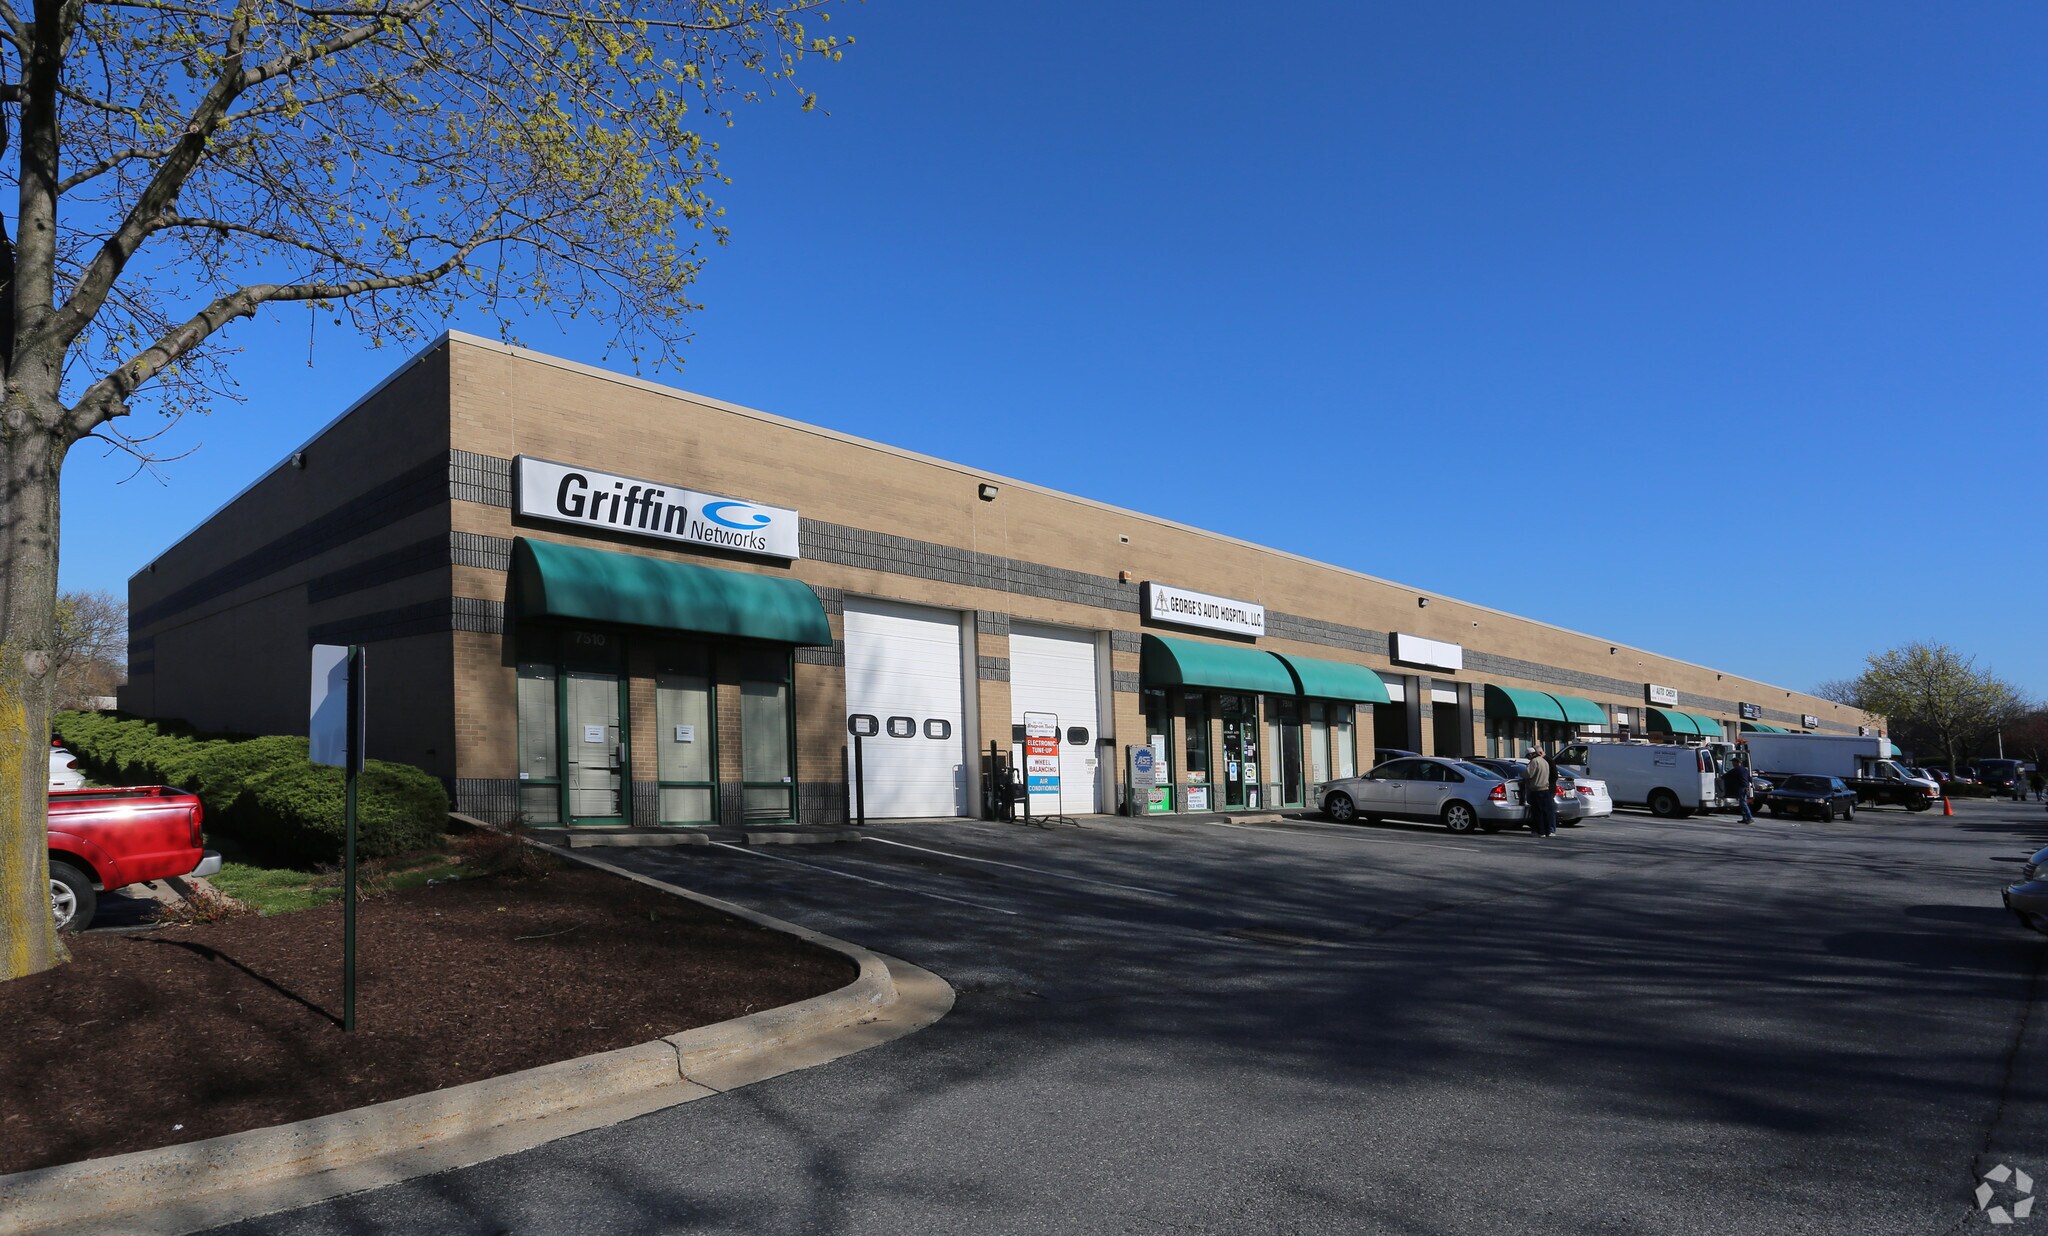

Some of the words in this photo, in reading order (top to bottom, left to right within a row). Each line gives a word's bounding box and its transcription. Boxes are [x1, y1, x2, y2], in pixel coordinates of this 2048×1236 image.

[556, 473, 688, 535] Griffin
[690, 520, 766, 550] Networks
[1170, 596, 1202, 616] GEORGE'S
[1203, 603, 1219, 619] AUTO
[576, 632, 606, 646] 7510
[1656, 688, 1665, 696] AUTO
[1137, 756, 1151, 765] ASE
